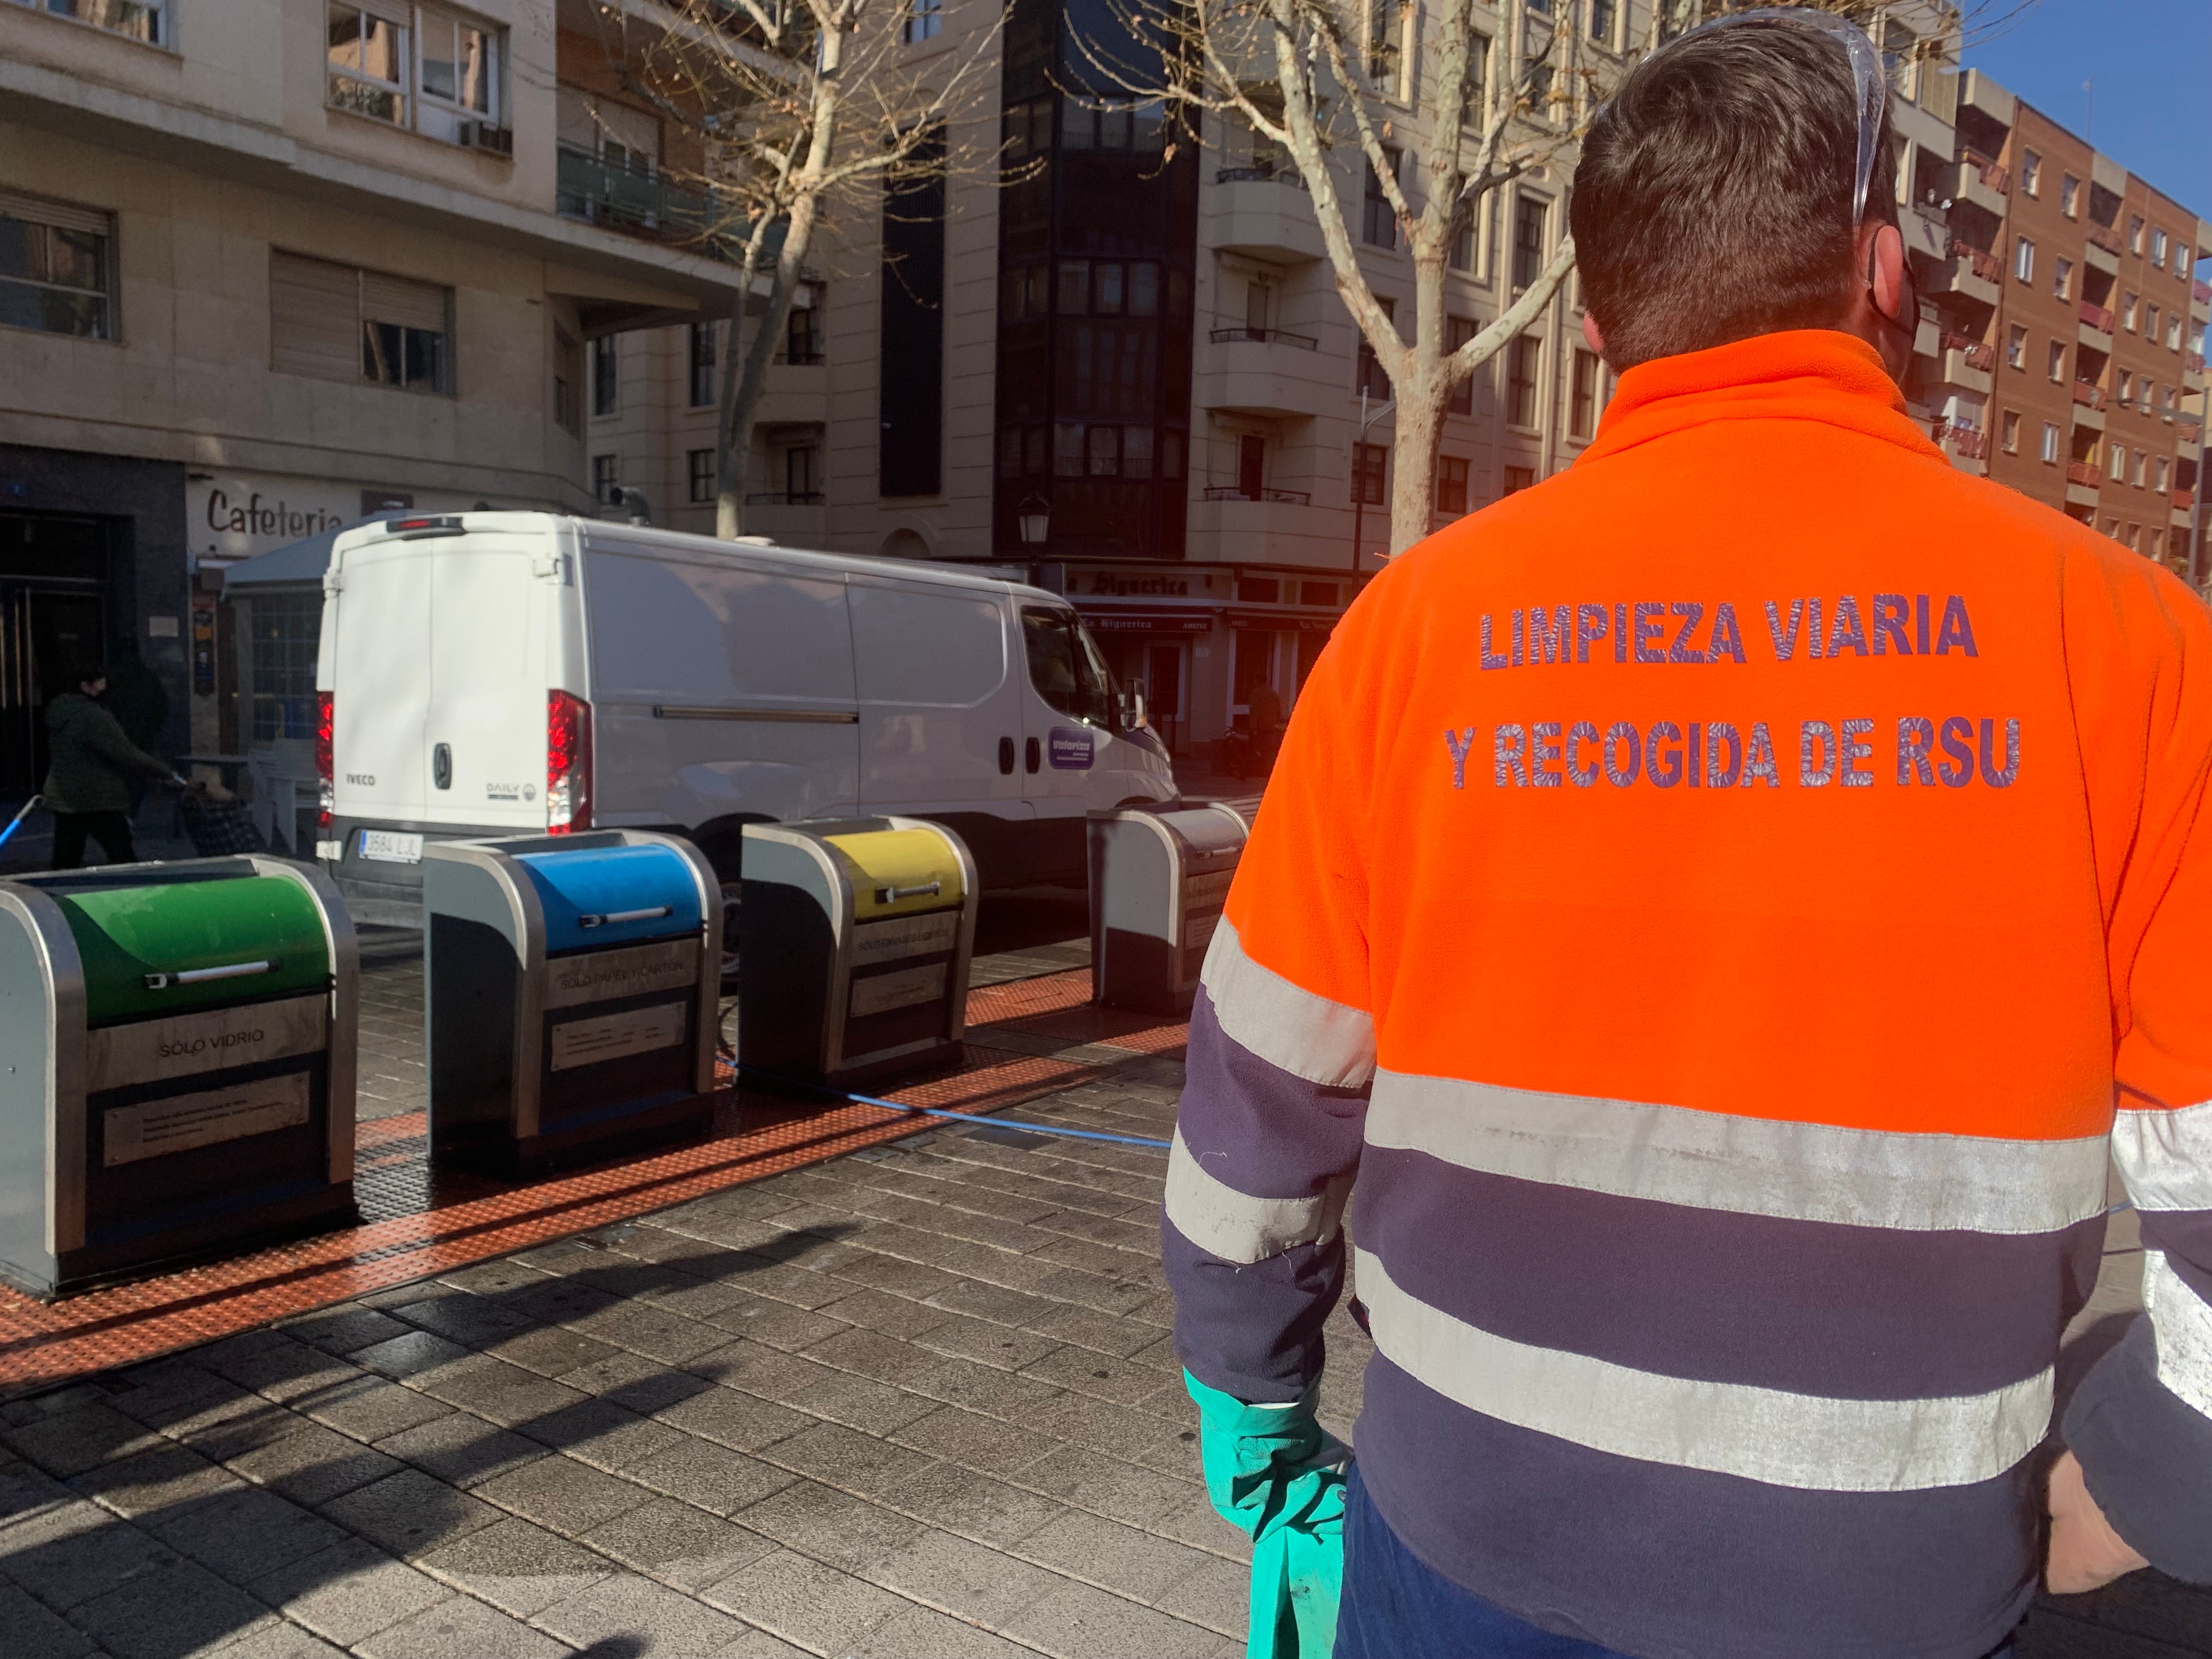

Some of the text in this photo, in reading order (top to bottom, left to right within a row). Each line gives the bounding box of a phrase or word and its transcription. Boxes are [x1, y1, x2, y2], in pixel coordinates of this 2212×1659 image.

[207, 489, 343, 537] Cafeteria
[1480, 594, 1979, 671] LIMPIEZA VIARIA
[1444, 716, 2019, 788] Y RECOGIDA DE RSU
[347, 774, 375, 786] IVECO
[487, 783, 519, 793] DAILY
[210, 1029, 264, 1049] VIDRIO
